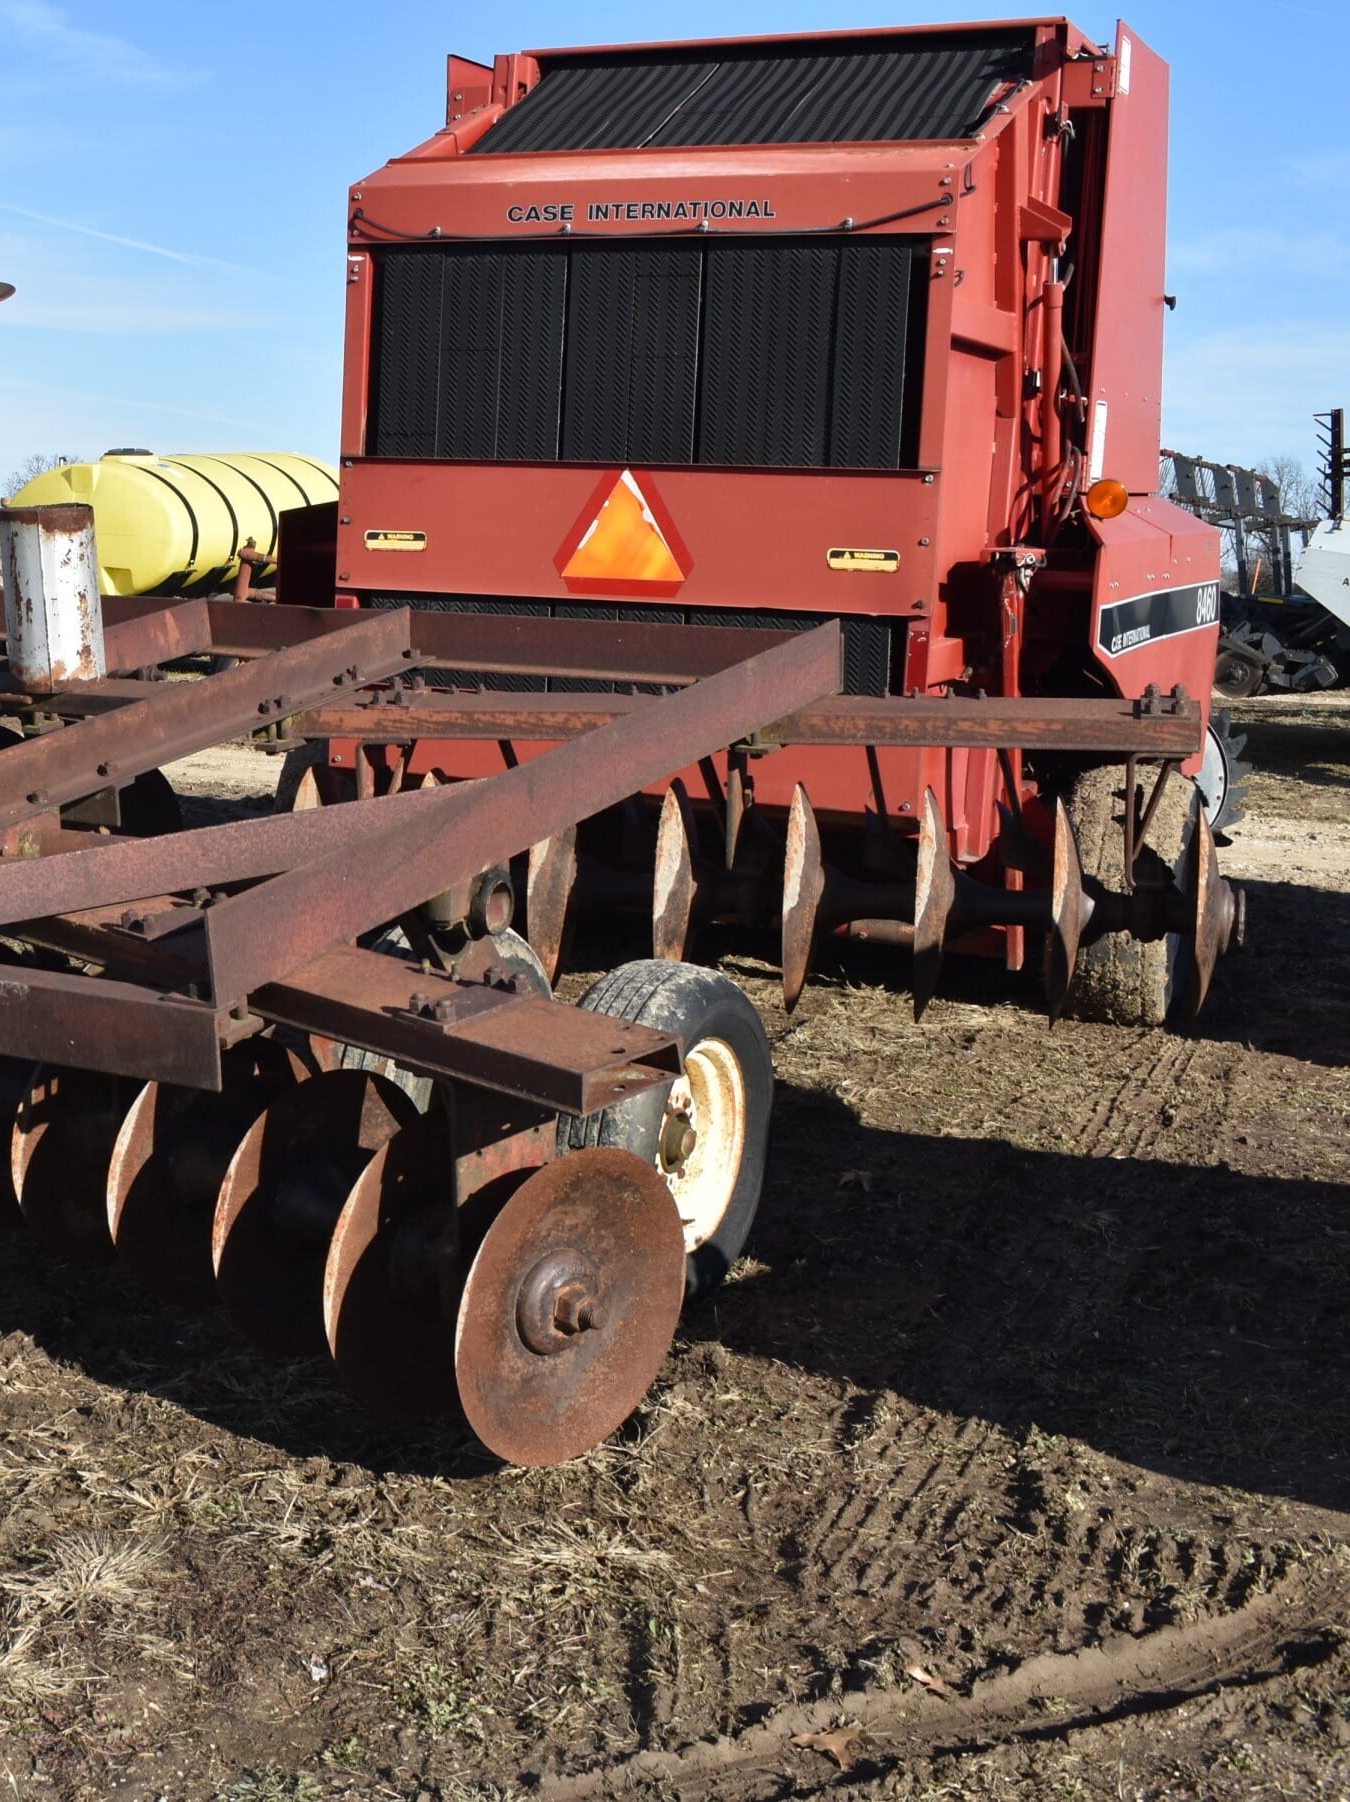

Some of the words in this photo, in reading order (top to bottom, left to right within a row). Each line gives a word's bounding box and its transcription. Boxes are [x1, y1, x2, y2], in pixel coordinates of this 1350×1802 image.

[507, 204, 574, 223] CASE
[587, 200, 776, 221] INTERNATIONAL
[1196, 584, 1217, 625] 8460
[1111, 633, 1123, 653] CASE
[1122, 624, 1150, 648] INTERNATIONAL
